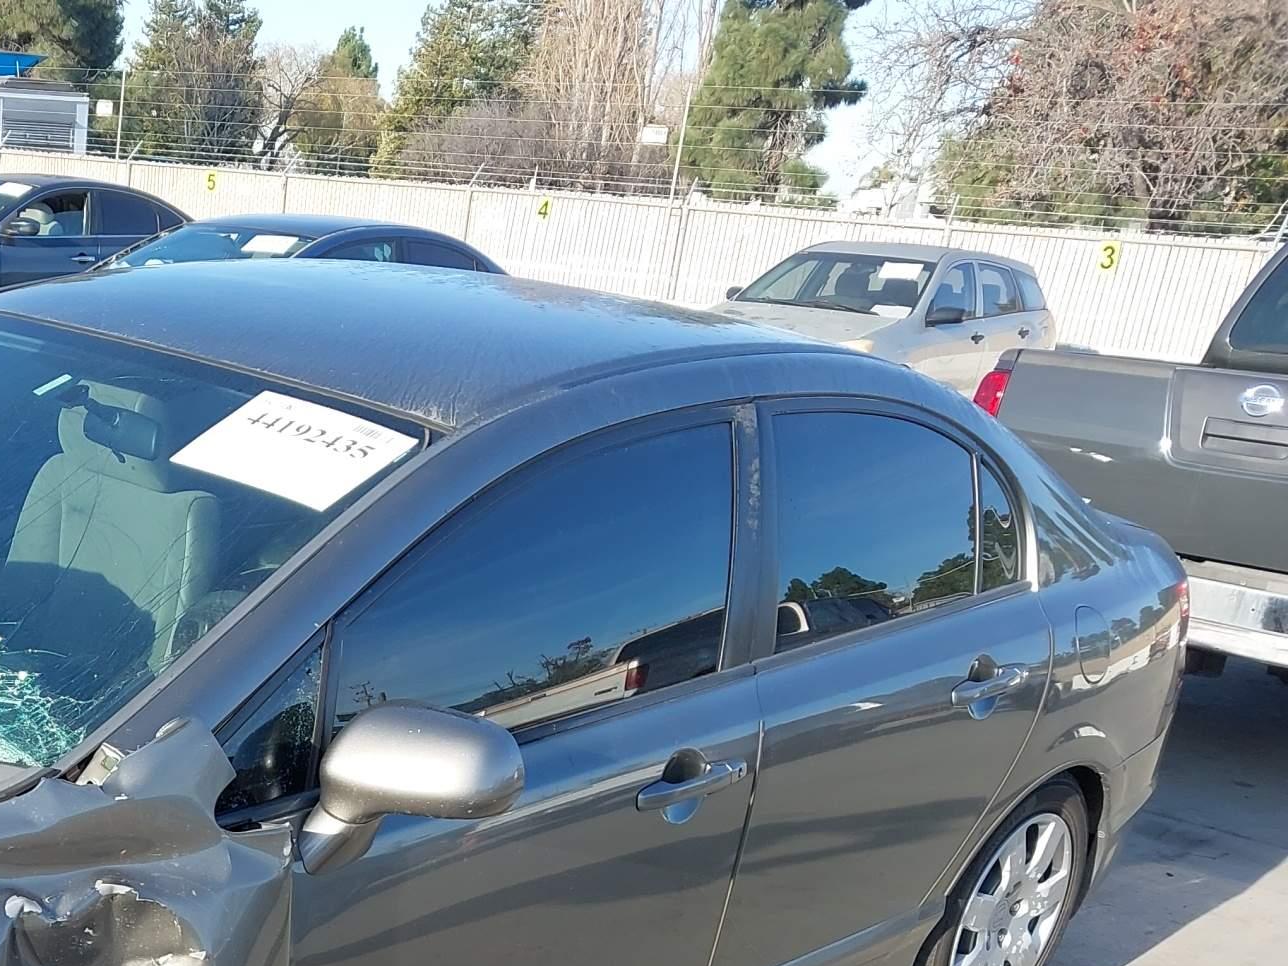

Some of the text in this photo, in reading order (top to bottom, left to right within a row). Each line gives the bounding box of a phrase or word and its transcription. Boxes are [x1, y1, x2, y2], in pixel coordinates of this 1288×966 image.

[207, 173, 216, 191] 5
[537, 199, 549, 220] 4
[1100, 245, 1116, 269] 3
[246, 412, 376, 459] 44192435
